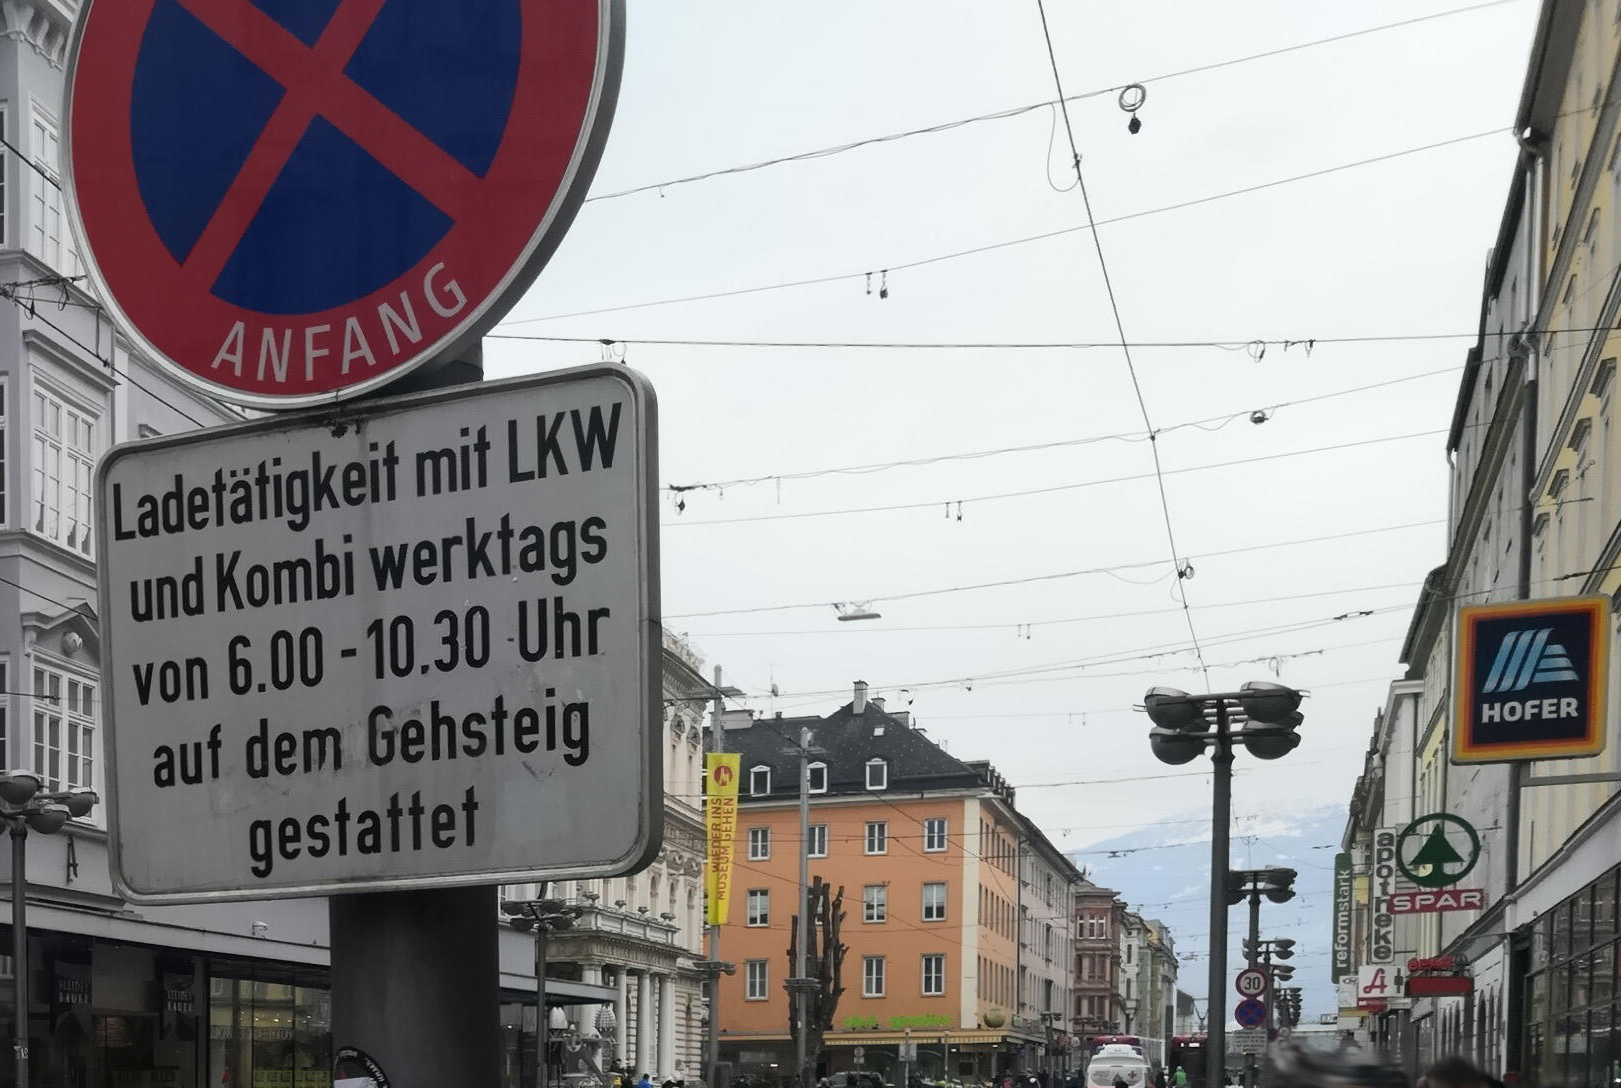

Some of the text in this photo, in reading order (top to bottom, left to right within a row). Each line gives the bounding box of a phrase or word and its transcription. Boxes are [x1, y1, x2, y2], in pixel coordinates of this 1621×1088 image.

[211, 261, 470, 384] ANFANG
[112, 402, 624, 542] Ladetätigkeit mit LKW
[130, 512, 609, 624] und Kombi werktags
[132, 652, 209, 706] von
[228, 628, 325, 697] 6.00
[517, 598, 613, 661] Uhr
[152, 690, 592, 789] auf dem Gehsteig
[1481, 697, 1580, 724] HOFER
[249, 786, 481, 880] gestattet
[710, 797, 723, 873] WIEDER INS
[717, 797, 734, 901] MUSEUM GEHEN
[1334, 869, 1351, 968] reformstark
[1393, 891, 1483, 911] SPAR
[1244, 976, 1261, 991] 30
